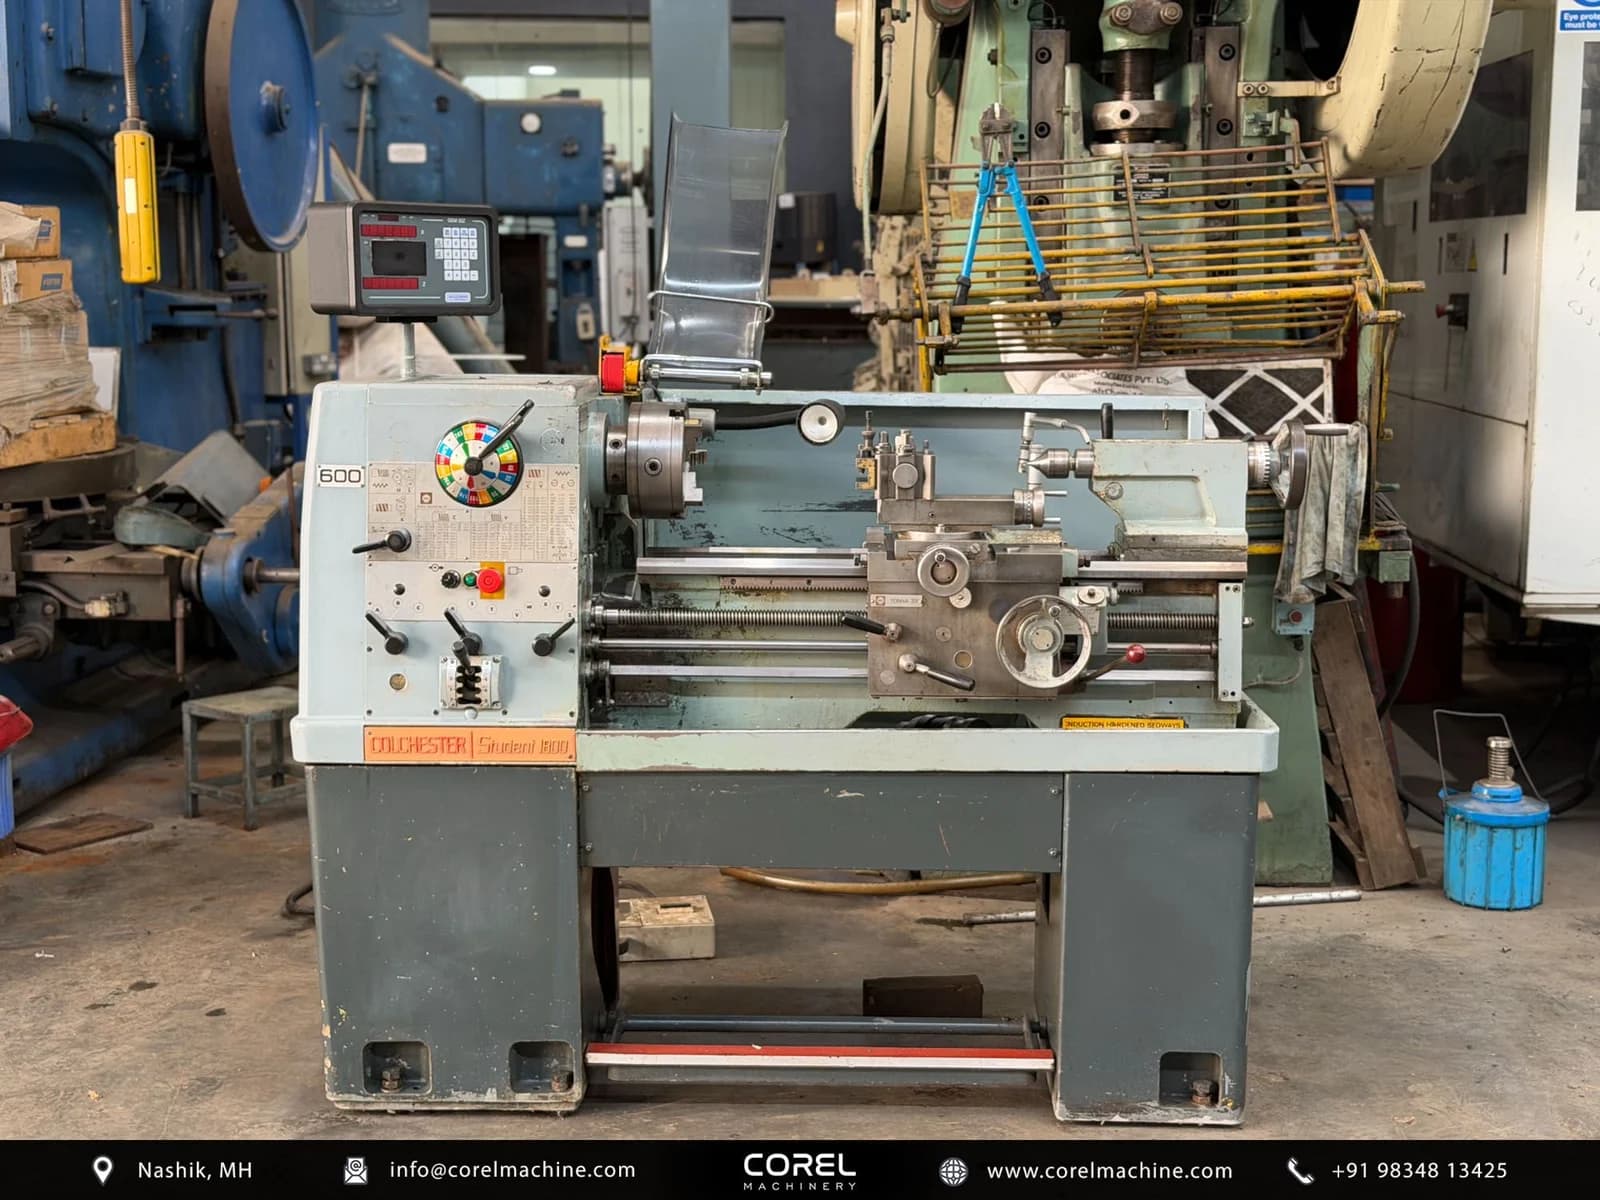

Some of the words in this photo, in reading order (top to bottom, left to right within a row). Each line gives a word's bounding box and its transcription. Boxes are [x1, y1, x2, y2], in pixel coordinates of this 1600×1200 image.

[1563, 12, 1579, 21] Eye
[1586, 20, 1597, 28] be
[320, 469, 362, 483] 600
[372, 735, 466, 754] COLCHESTER
[479, 736, 536, 755] Student
[539, 739, 569, 755] 1800
